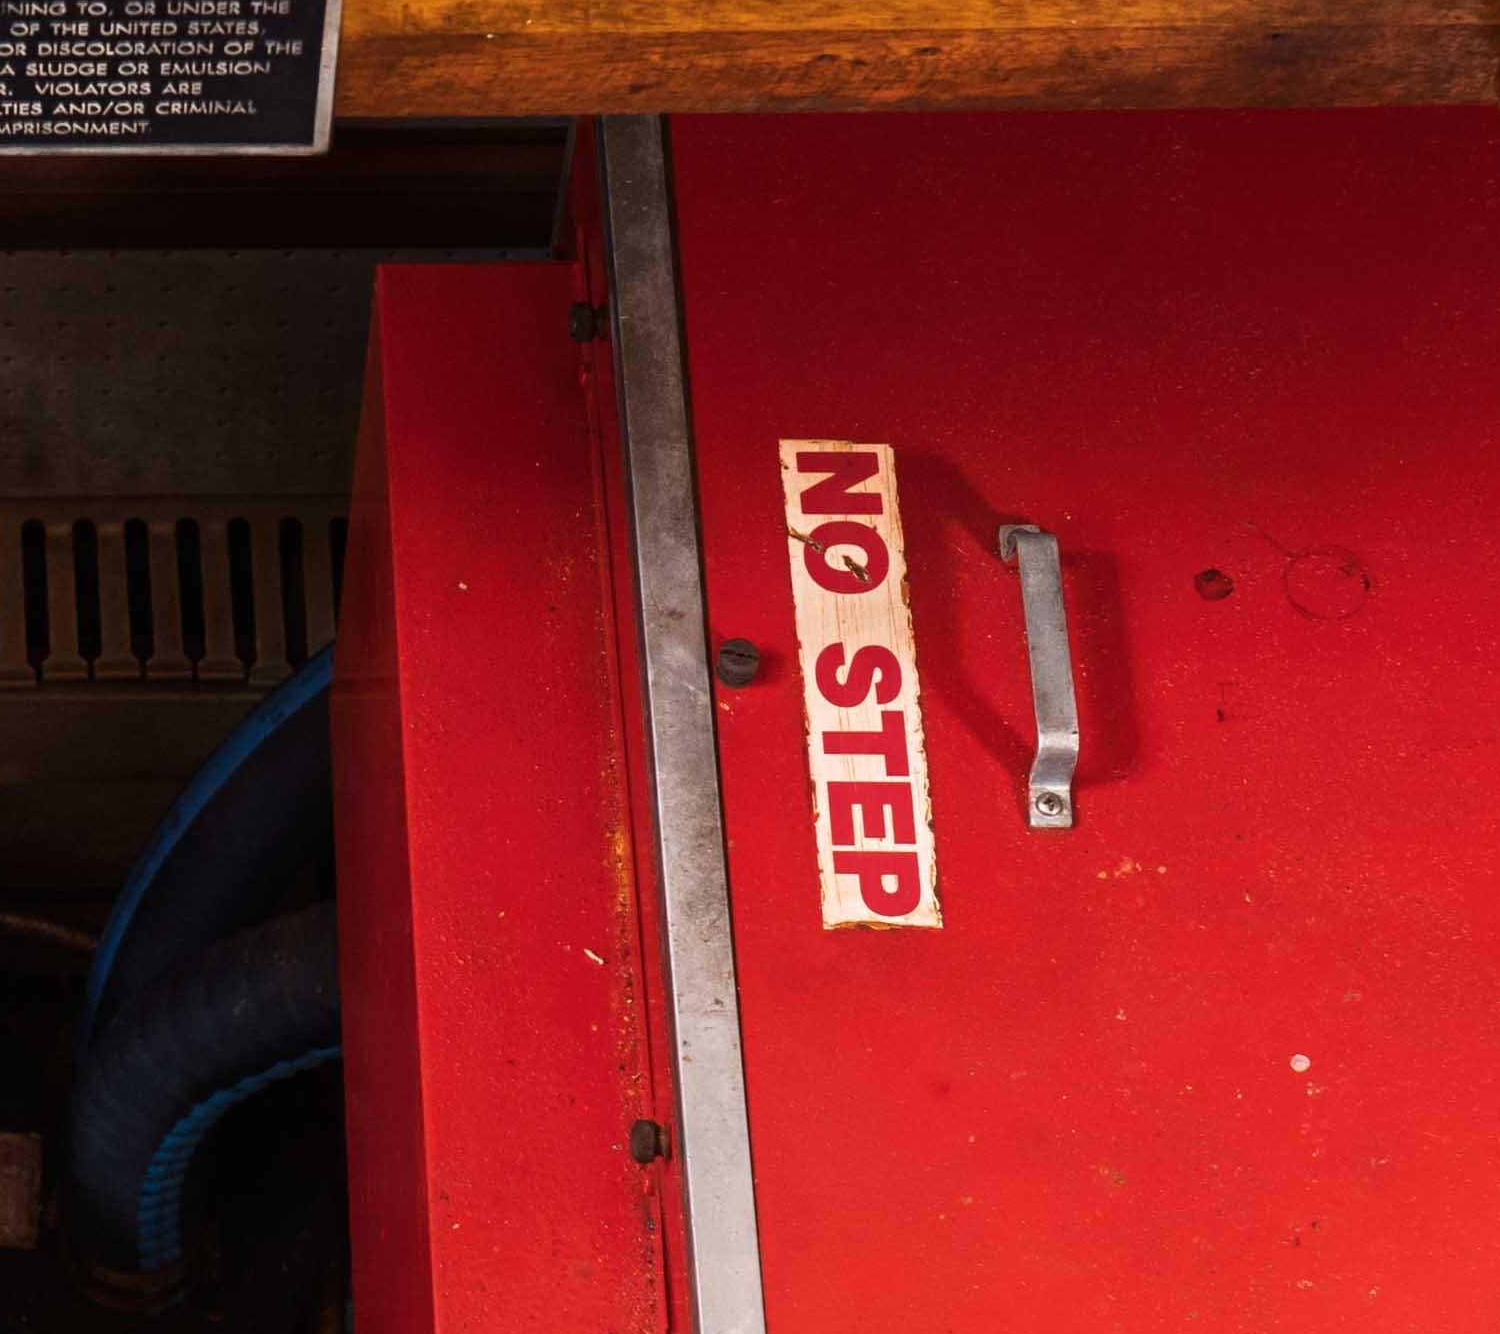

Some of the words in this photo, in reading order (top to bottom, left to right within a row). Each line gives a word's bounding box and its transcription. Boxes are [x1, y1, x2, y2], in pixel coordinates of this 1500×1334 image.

[124, 1, 157, 16] OR
[167, 0, 241, 16] UNDER
[250, 0, 291, 15] THE
[10, 22, 41, 37] OF
[49, 21, 90, 36] THE
[100, 21, 178, 36] UNITED
[37, 41, 214, 57] DISCOLORATION
[223, 41, 255, 56] OF
[265, 40, 304, 55] THE
[0, 63, 16, 77] A
[25, 62, 108, 77] SLUDGE
[117, 62, 150, 77] OR
[160, 61, 271, 76] EMULSION
[34, 82, 151, 96] VIOLATORS
[161, 82, 203, 95] ARE
[52, 101, 146, 116] AND/OR
[155, 99, 257, 115] CRIMINAL
[796, 451, 890, 594] NO
[815, 642, 921, 918] STEP
